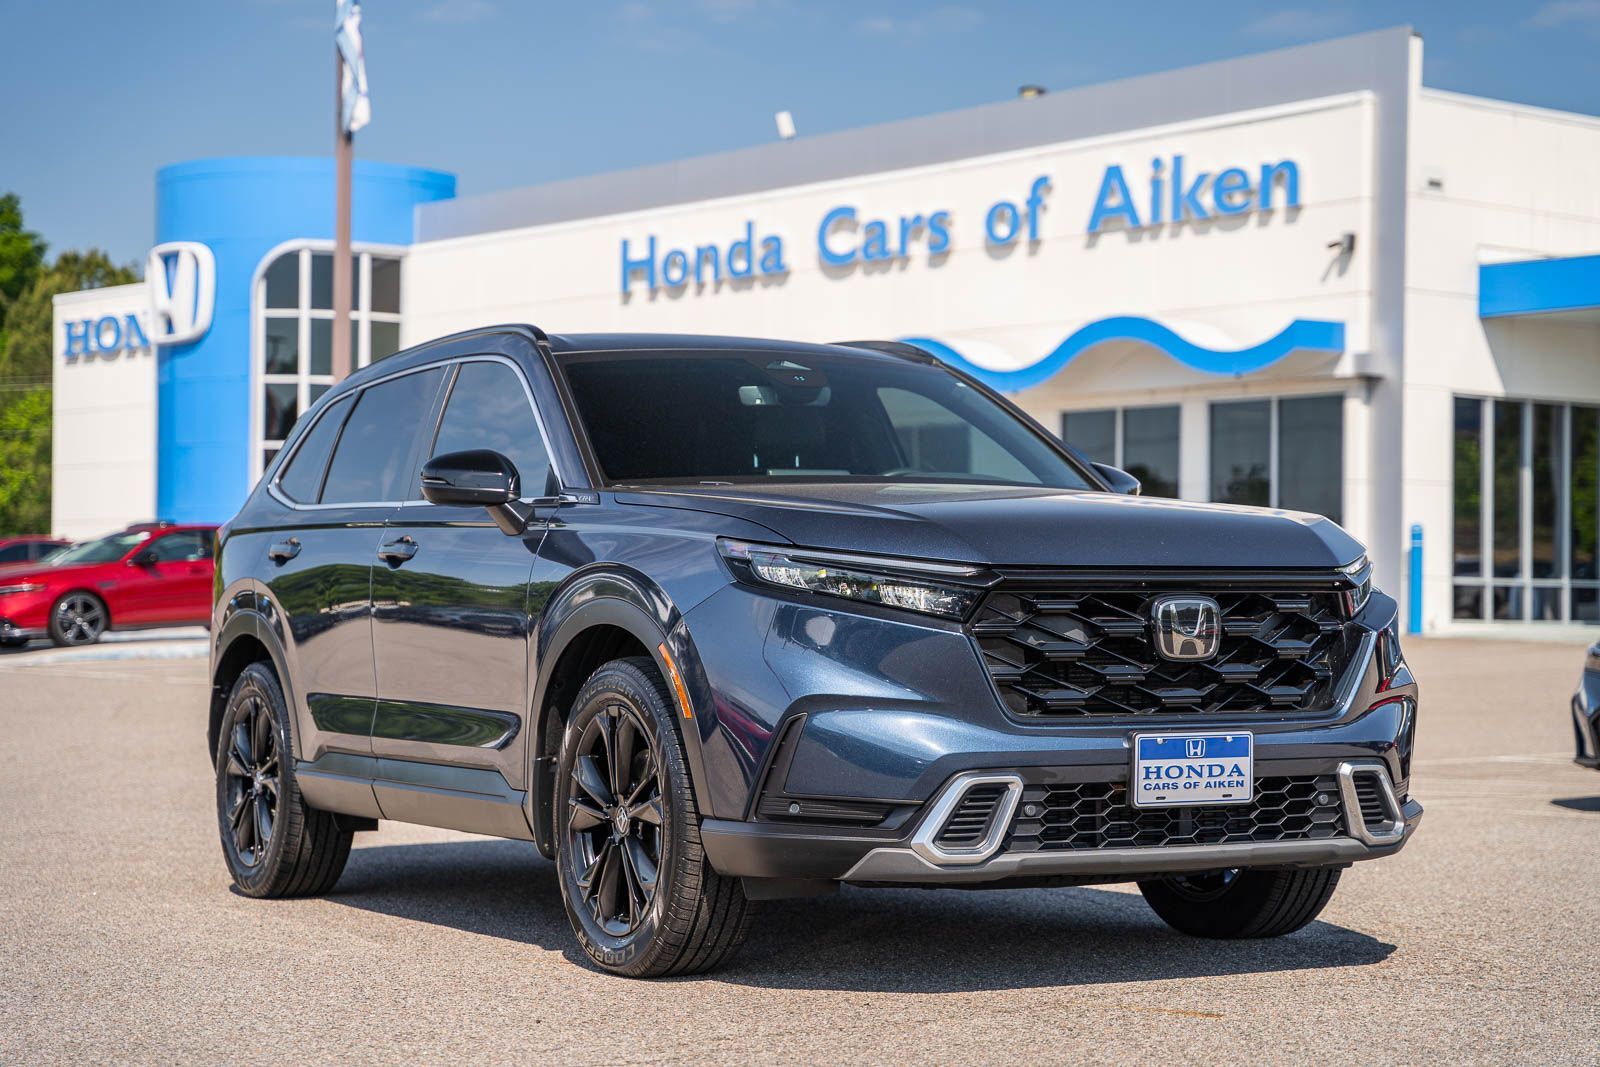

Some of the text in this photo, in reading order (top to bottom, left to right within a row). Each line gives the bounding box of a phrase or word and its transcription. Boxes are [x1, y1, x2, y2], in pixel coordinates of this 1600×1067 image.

[621, 155, 1299, 293] Honda Cars of Aiken
[1142, 763, 1245, 780] HONDA
[1143, 780, 1244, 791] CARS OF AIKEN
